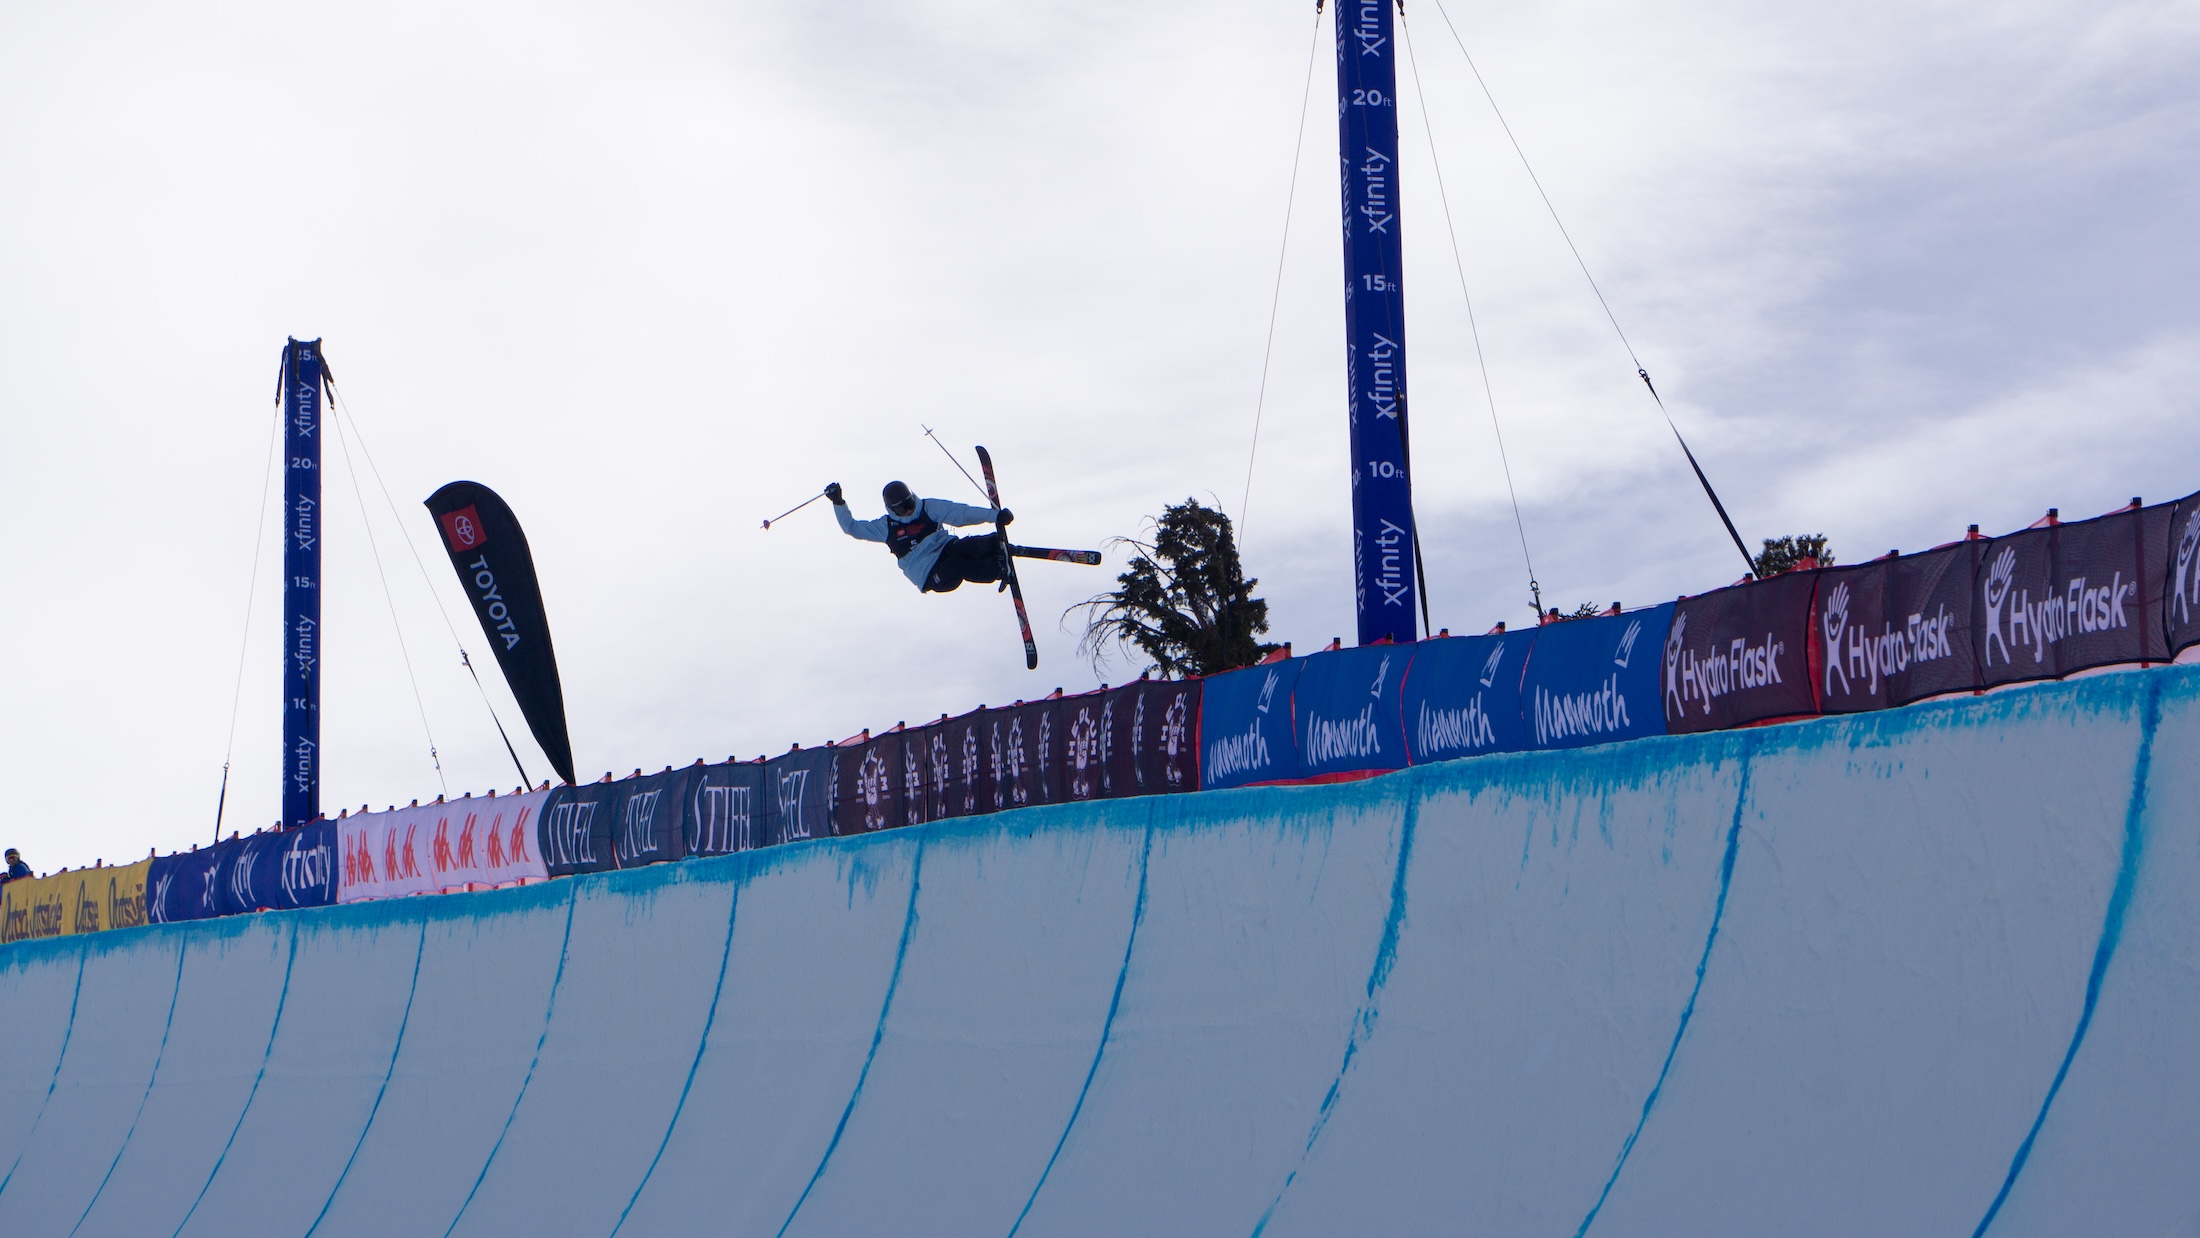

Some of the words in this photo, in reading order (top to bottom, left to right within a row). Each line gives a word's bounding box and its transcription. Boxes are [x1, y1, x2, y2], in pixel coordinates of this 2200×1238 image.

[1353, 0, 1386, 57] xfini
[1360, 146, 1393, 235] xfinity
[293, 381, 316, 438] xfinity
[1367, 332, 1398, 420] xfinity
[294, 493, 316, 551] xfinity
[1375, 518, 1409, 607] xfinity
[469, 554, 521, 651] TOYOTA
[2010, 585, 2065, 663] Hydro
[2067, 571, 2128, 636] Flask
[294, 614, 316, 672] xfinity
[1682, 645, 1729, 715] Hydro
[1731, 632, 1783, 692] Flask
[1849, 621, 1908, 696] Hydro
[1306, 702, 1381, 767] Mammoth
[1417, 690, 1496, 757] Mammoth
[1534, 672, 1630, 745] Mammoth
[294, 735, 316, 793] xfinity
[1207, 716, 1271, 784] Mammoth
